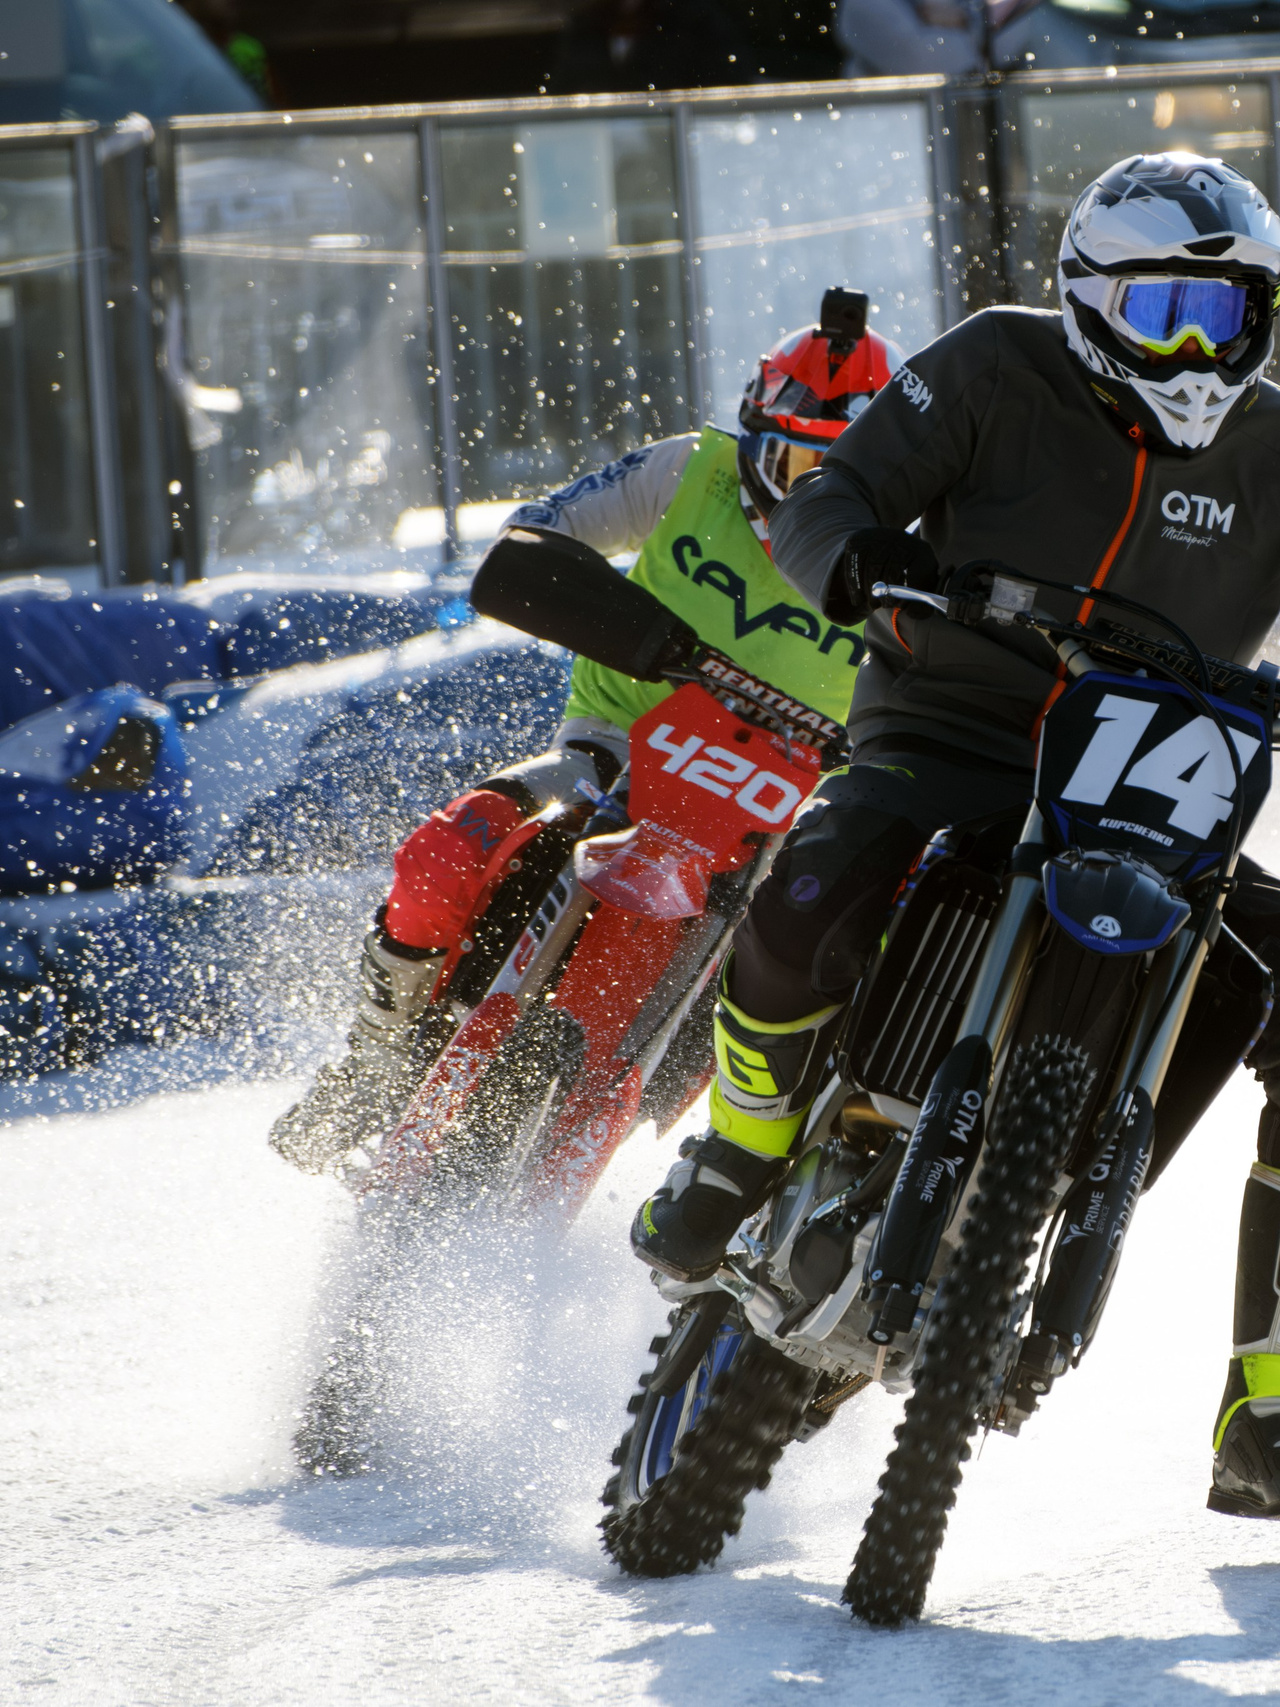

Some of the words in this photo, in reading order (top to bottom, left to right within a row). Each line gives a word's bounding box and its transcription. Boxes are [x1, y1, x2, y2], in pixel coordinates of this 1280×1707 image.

[1161, 490, 1236, 534] QTM
[1161, 525, 1218, 550] Motorsport
[700, 657, 839, 738] RENTHAL
[647, 723, 802, 825] 420
[1059, 693, 1261, 841] 14
[1098, 817, 1174, 847] KUPCHENKO
[950, 1089, 982, 1144] QTM
[919, 1161, 945, 1204] PRIME
[1083, 1190, 1105, 1231] PRIME
[1096, 1204, 1110, 1233] SERVICE
